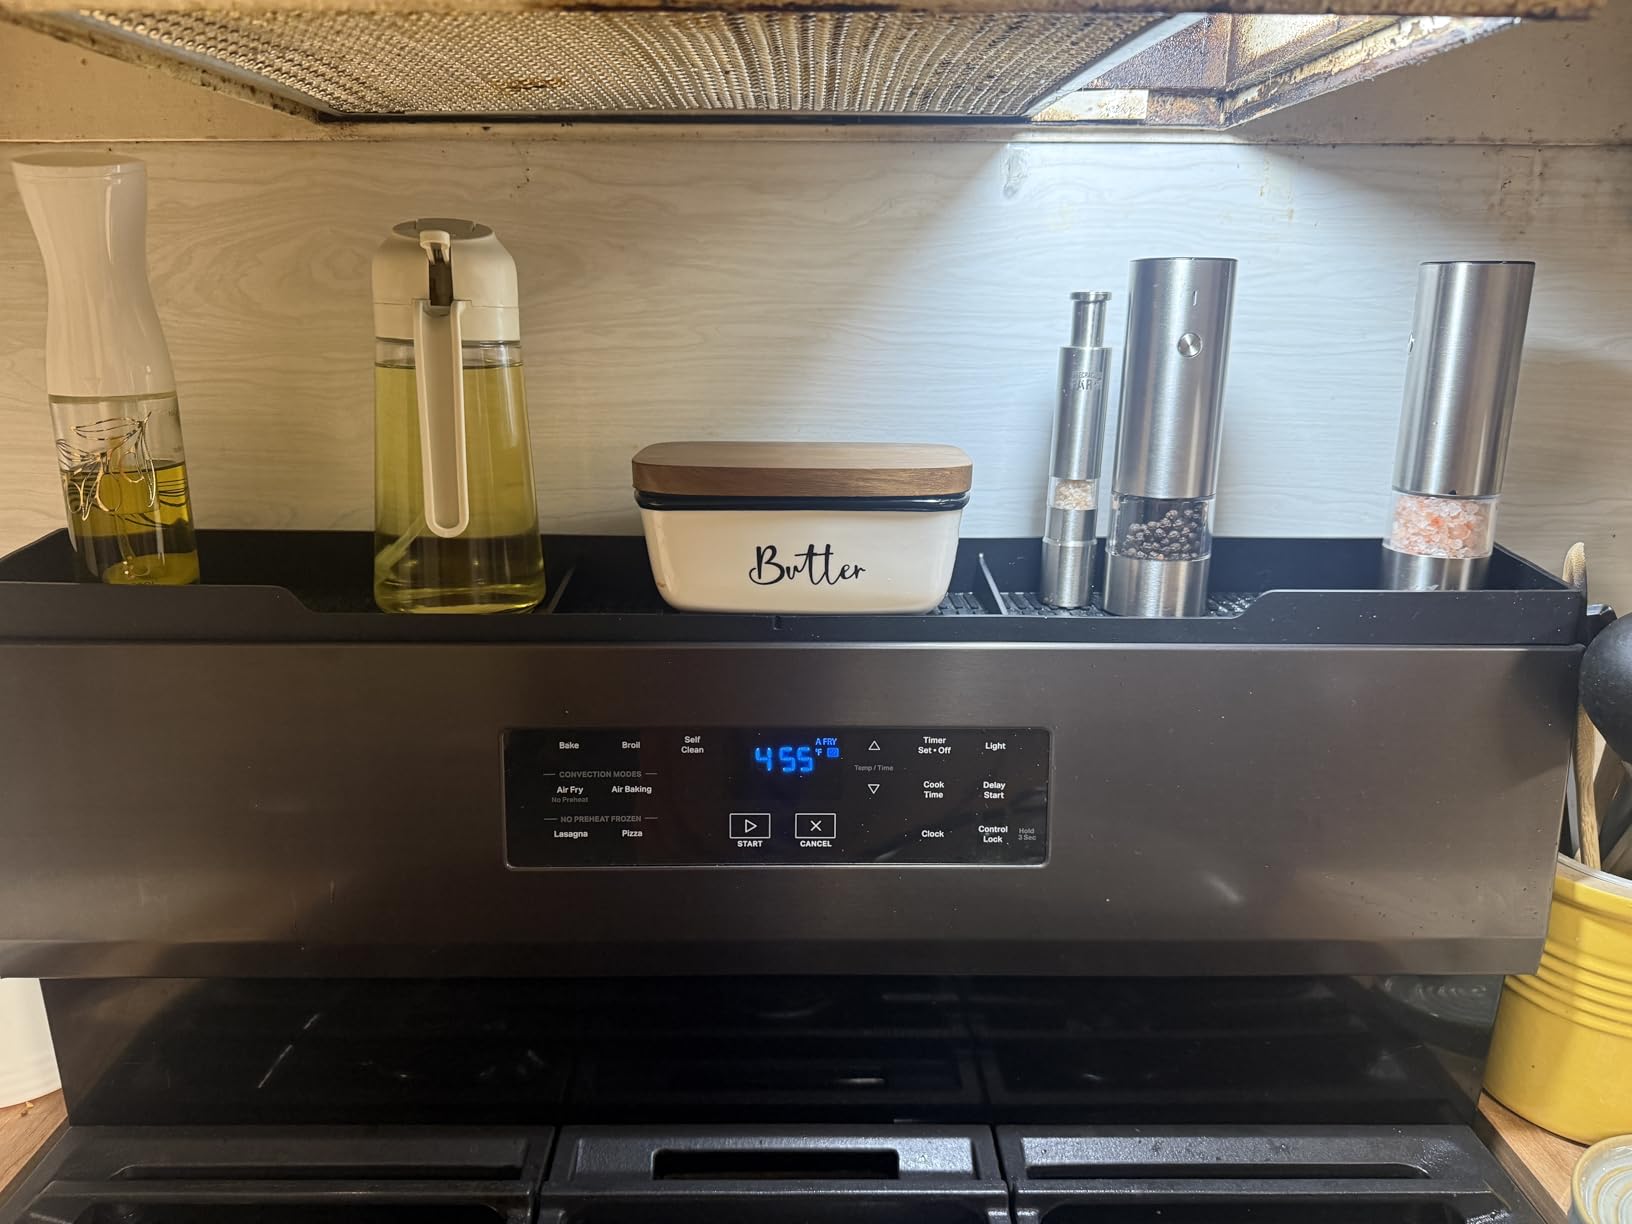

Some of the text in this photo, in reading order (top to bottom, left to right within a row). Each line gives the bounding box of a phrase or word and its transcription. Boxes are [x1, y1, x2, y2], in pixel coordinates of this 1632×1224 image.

[749, 544, 866, 585] Butter
[684, 735, 701, 744] Self
[923, 736, 947, 745] Timer
[559, 741, 580, 750] Bake
[621, 741, 641, 749] Broil
[985, 742, 1007, 752] Light
[681, 745, 705, 755] Clean
[918, 746, 952, 755] Set Off
[754, 746, 815, 773] 455
[854, 764, 873, 773] Temp
[877, 764, 894, 772] Time
[559, 770, 642, 779] CONVECTION MODES
[923, 780, 945, 789] Cook
[983, 781, 1006, 791] Delay
[556, 785, 584, 795] Air Fry
[611, 785, 653, 795] Air Baking
[924, 790, 944, 799] Time
[983, 791, 1005, 800] Start
[560, 815, 573, 823] NO
[574, 815, 610, 823] PREHEAT
[621, 829, 643, 838] Pizza
[921, 829, 945, 838] Clock
[978, 825, 1009, 834] Control
[1018, 827, 1035, 835] Hold
[553, 829, 589, 840] Lasagna
[737, 840, 763, 848] START
[799, 840, 833, 848] CANCEL
[983, 835, 1003, 844] Lock
